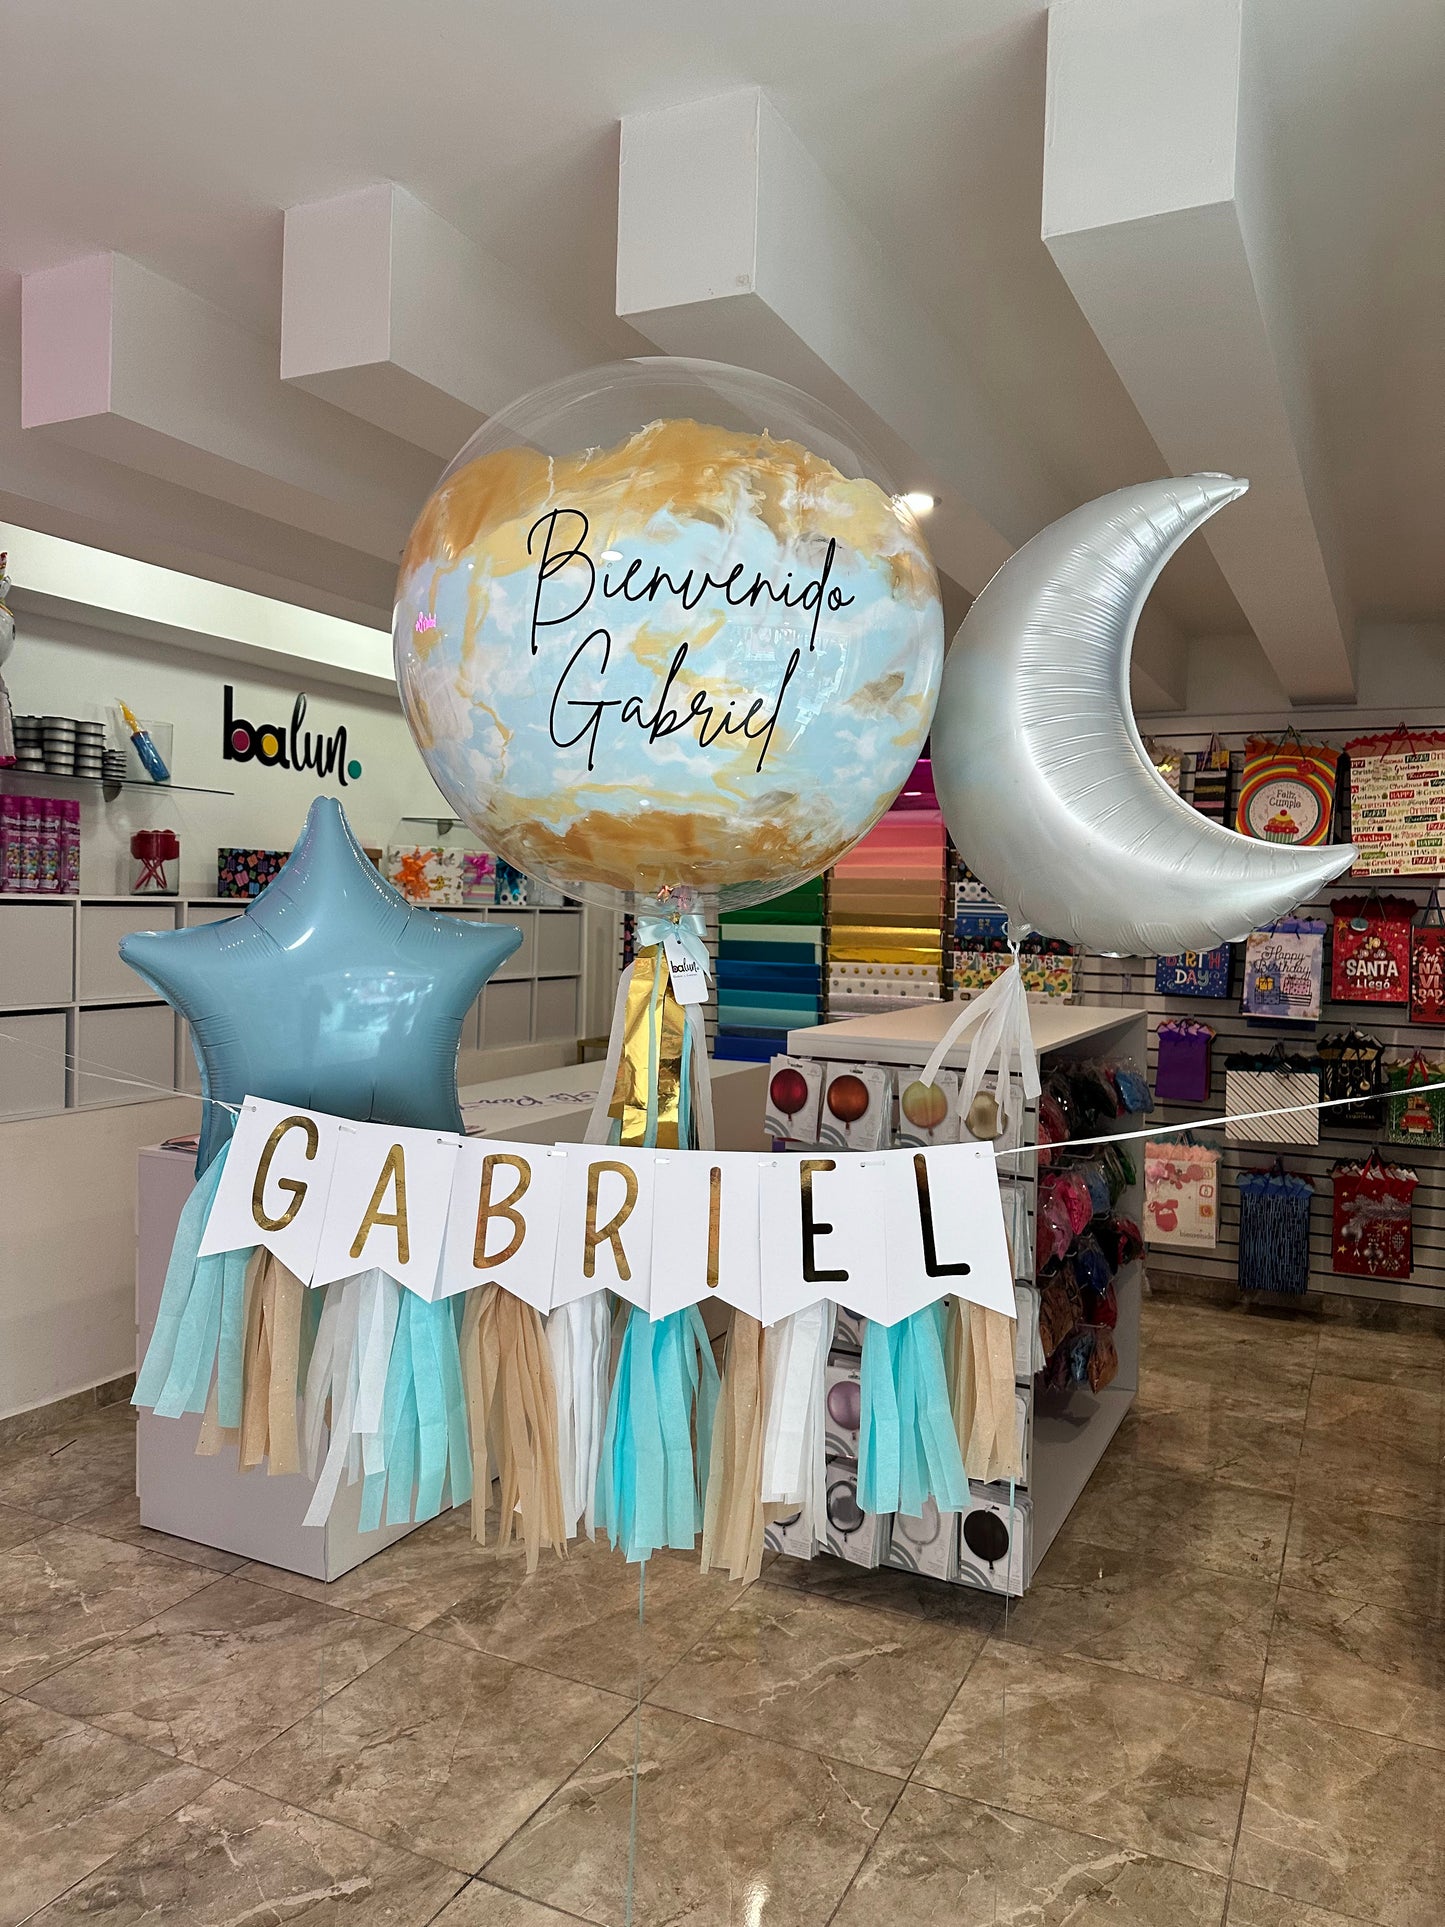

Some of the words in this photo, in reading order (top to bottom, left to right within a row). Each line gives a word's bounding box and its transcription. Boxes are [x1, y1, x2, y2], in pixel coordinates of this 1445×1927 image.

[528, 508, 855, 655] Bienvenido
[549, 628, 801, 772] Gabriel
[1346, 958, 1399, 977] SANTA
[1174, 969, 1210, 986] DAY
[1356, 978, 1391, 991] Llegó
[1419, 974, 1440, 989] VI
[251, 1115, 971, 1288] GABRIEL
